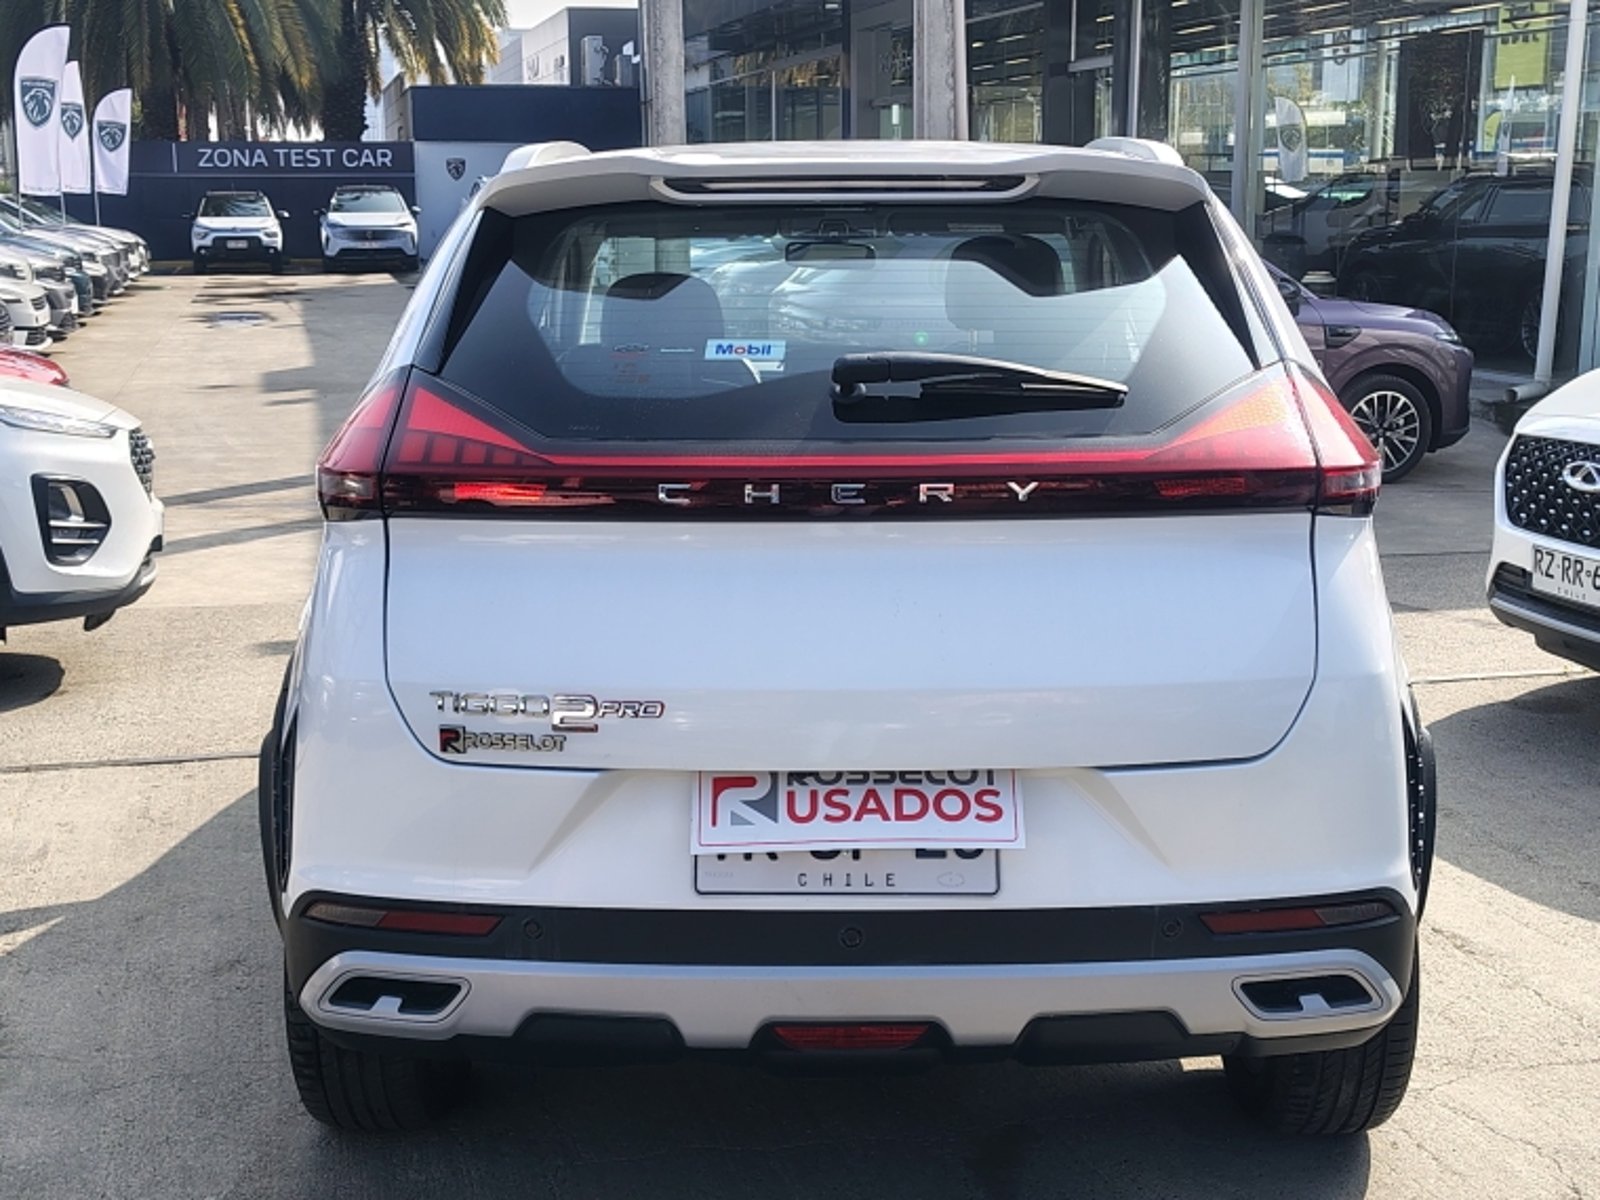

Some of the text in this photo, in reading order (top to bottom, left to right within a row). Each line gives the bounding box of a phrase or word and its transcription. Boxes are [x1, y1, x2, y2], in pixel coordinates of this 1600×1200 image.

[198, 149, 393, 167] ZONA TEST CAR
[715, 344, 771, 356] Mobil
[658, 481, 1039, 504] CHERY
[429, 690, 665, 733] TIGGO 2 PRO
[466, 732, 566, 751] ROSSELOT
[786, 788, 1004, 823] USADOS
[797, 872, 896, 887] CHILE
